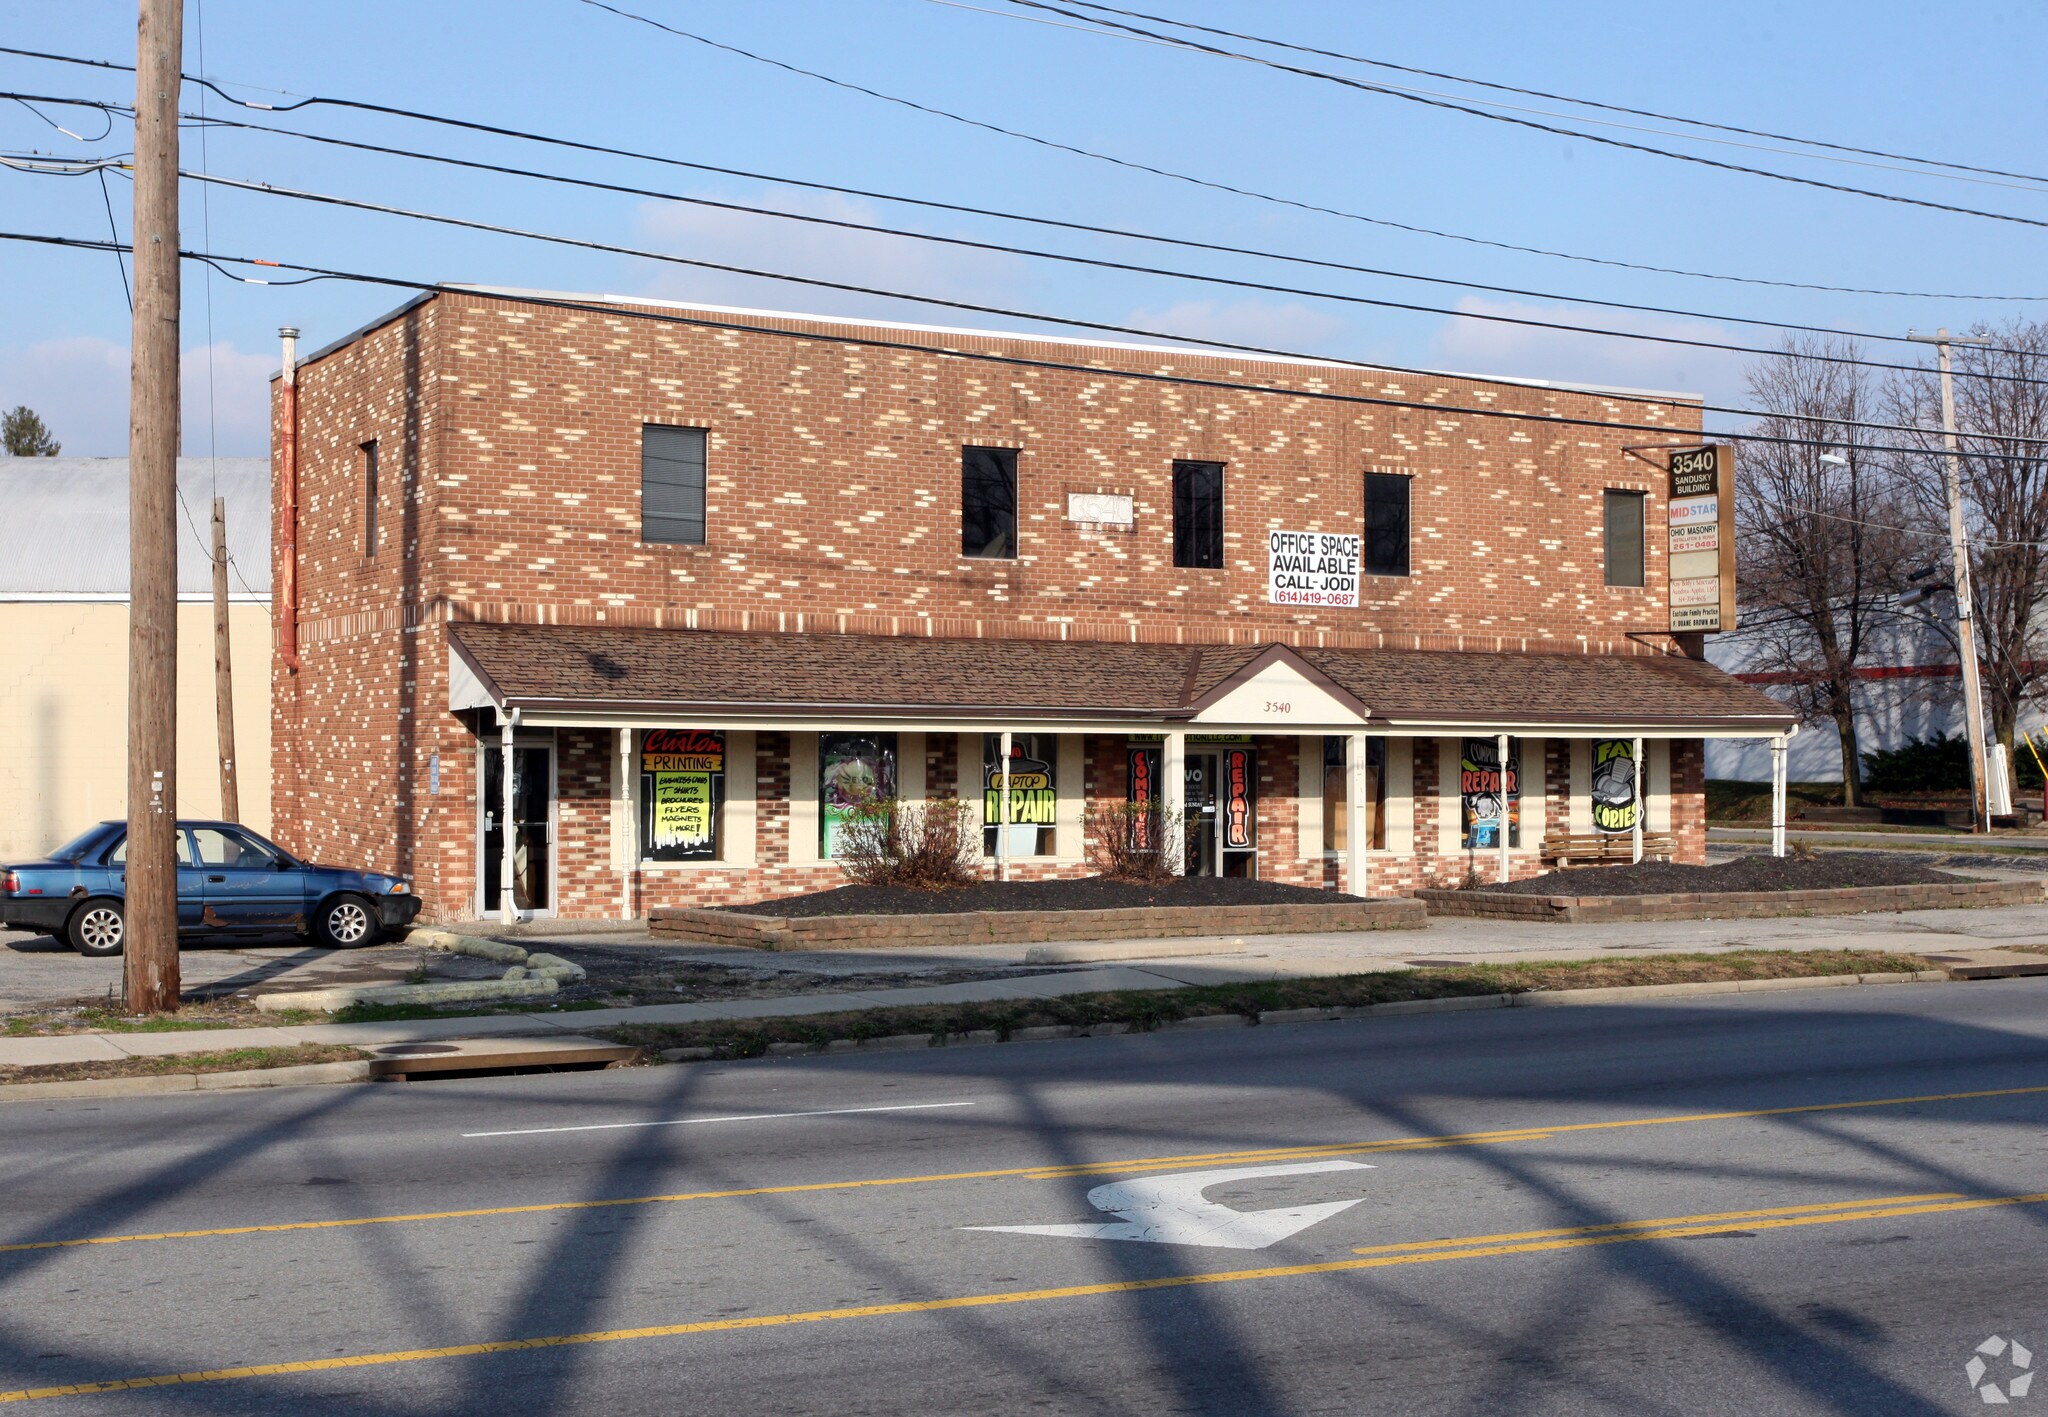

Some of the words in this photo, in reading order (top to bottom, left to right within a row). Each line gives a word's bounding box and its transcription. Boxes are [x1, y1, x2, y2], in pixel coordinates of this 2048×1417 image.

[1673, 452, 1713, 474] 3540
[1675, 473, 1712, 485] SANDUSKY
[1677, 483, 1710, 494] BUILDING
[1671, 528, 1685, 537] OHIO
[1687, 525, 1716, 535] MASONRY
[1270, 532, 1315, 555] OFFICE
[1321, 535, 1359, 557] SPACE
[1273, 555, 1356, 575] AVAILABLE
[1275, 590, 1355, 605] (614)419-0687
[1689, 609, 1702, 617] Family
[1702, 608, 1718, 616] Practice
[1678, 619, 1691, 627] DUANE
[1263, 701, 1291, 713] 3540
[1471, 742, 1499, 764] COMPUT
[653, 756, 714, 770] PRINTING
[659, 776, 692, 785] BUSINESS
[1462, 770, 1517, 793] REPAR
[673, 786, 699, 795] SHIRTS
[661, 797, 704, 805] BROCHURES
[1231, 752, 1246, 843] REPAIR
[665, 806, 700, 814] FLYERS
[661, 815, 702, 823] MAGNETS
